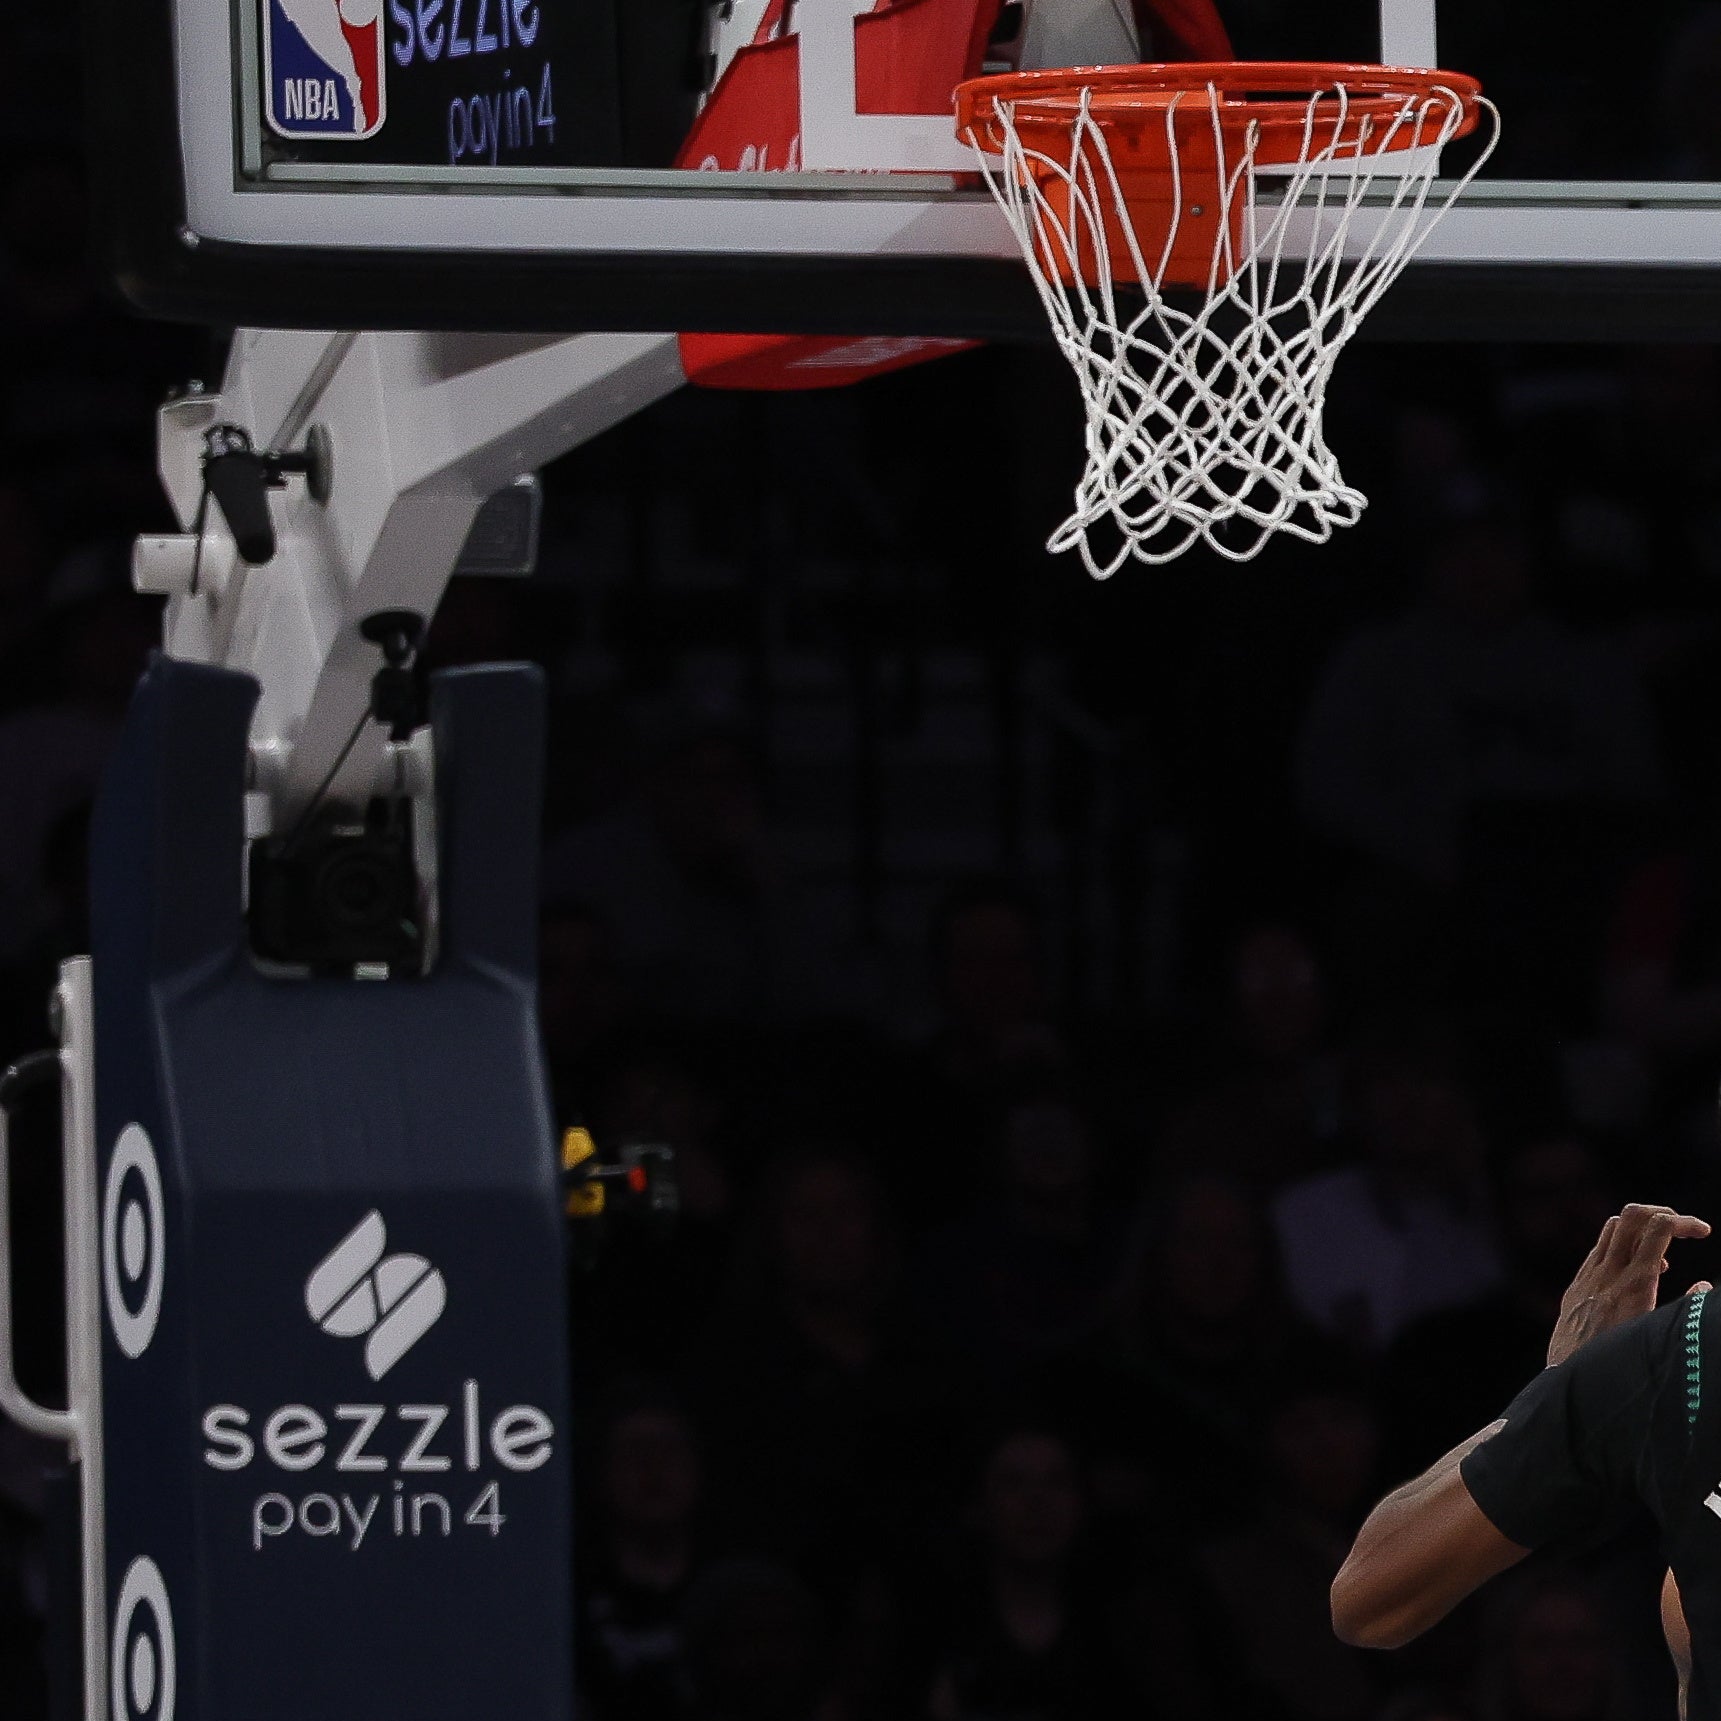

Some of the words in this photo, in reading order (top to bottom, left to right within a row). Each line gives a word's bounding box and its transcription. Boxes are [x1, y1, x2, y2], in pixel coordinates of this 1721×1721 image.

[284, 78, 340, 121] NBA
[201, 1378, 555, 1472] sezzle
[465, 1479, 506, 1537] 4
